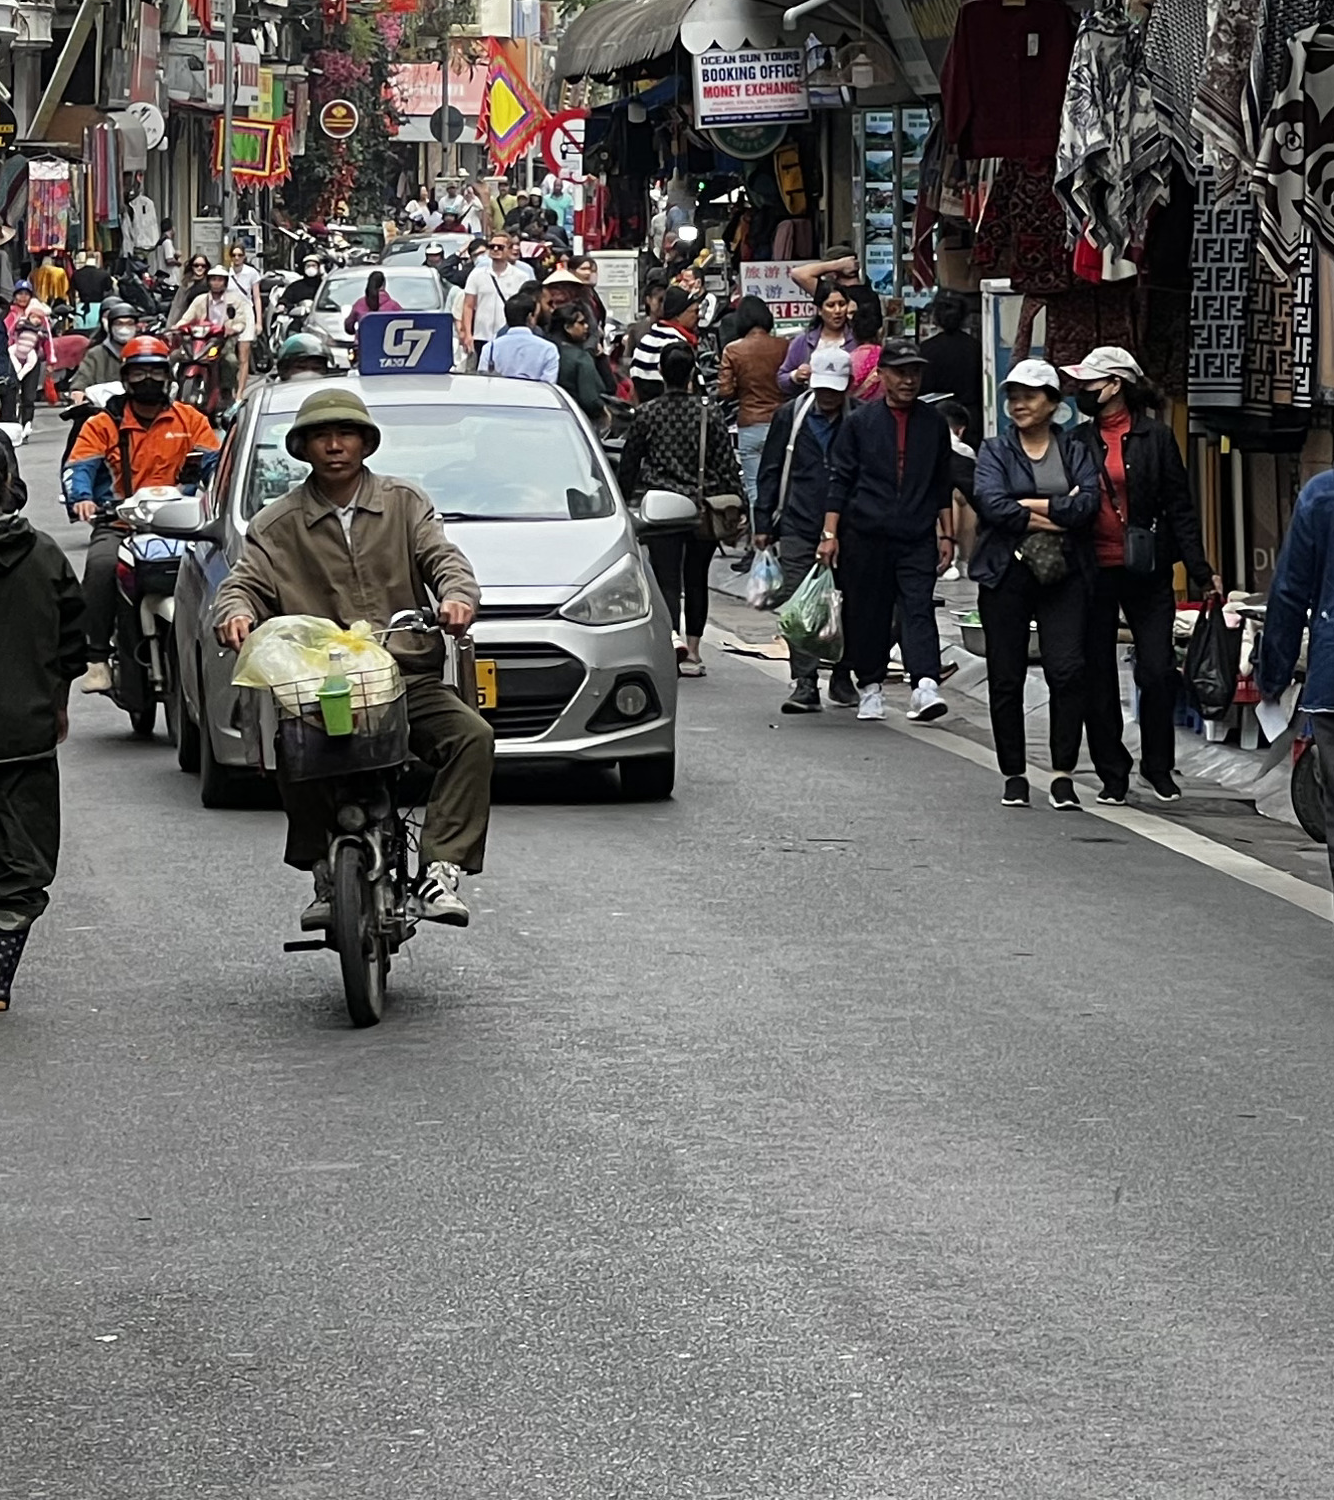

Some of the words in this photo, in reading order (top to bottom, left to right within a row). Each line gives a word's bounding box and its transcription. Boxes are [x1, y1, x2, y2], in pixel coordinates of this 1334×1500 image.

[701, 55, 733, 66] OCEAN
[738, 54, 761, 63] SUN
[763, 51, 800, 61] TOURS
[701, 66, 757, 82] BOOKING
[760, 63, 802, 79] OFFICE
[703, 84, 742, 99] MONEY
[744, 80, 803, 96] EXCHANGE
[383, 319, 436, 367] G7
[379, 358, 405, 368] TAXI
